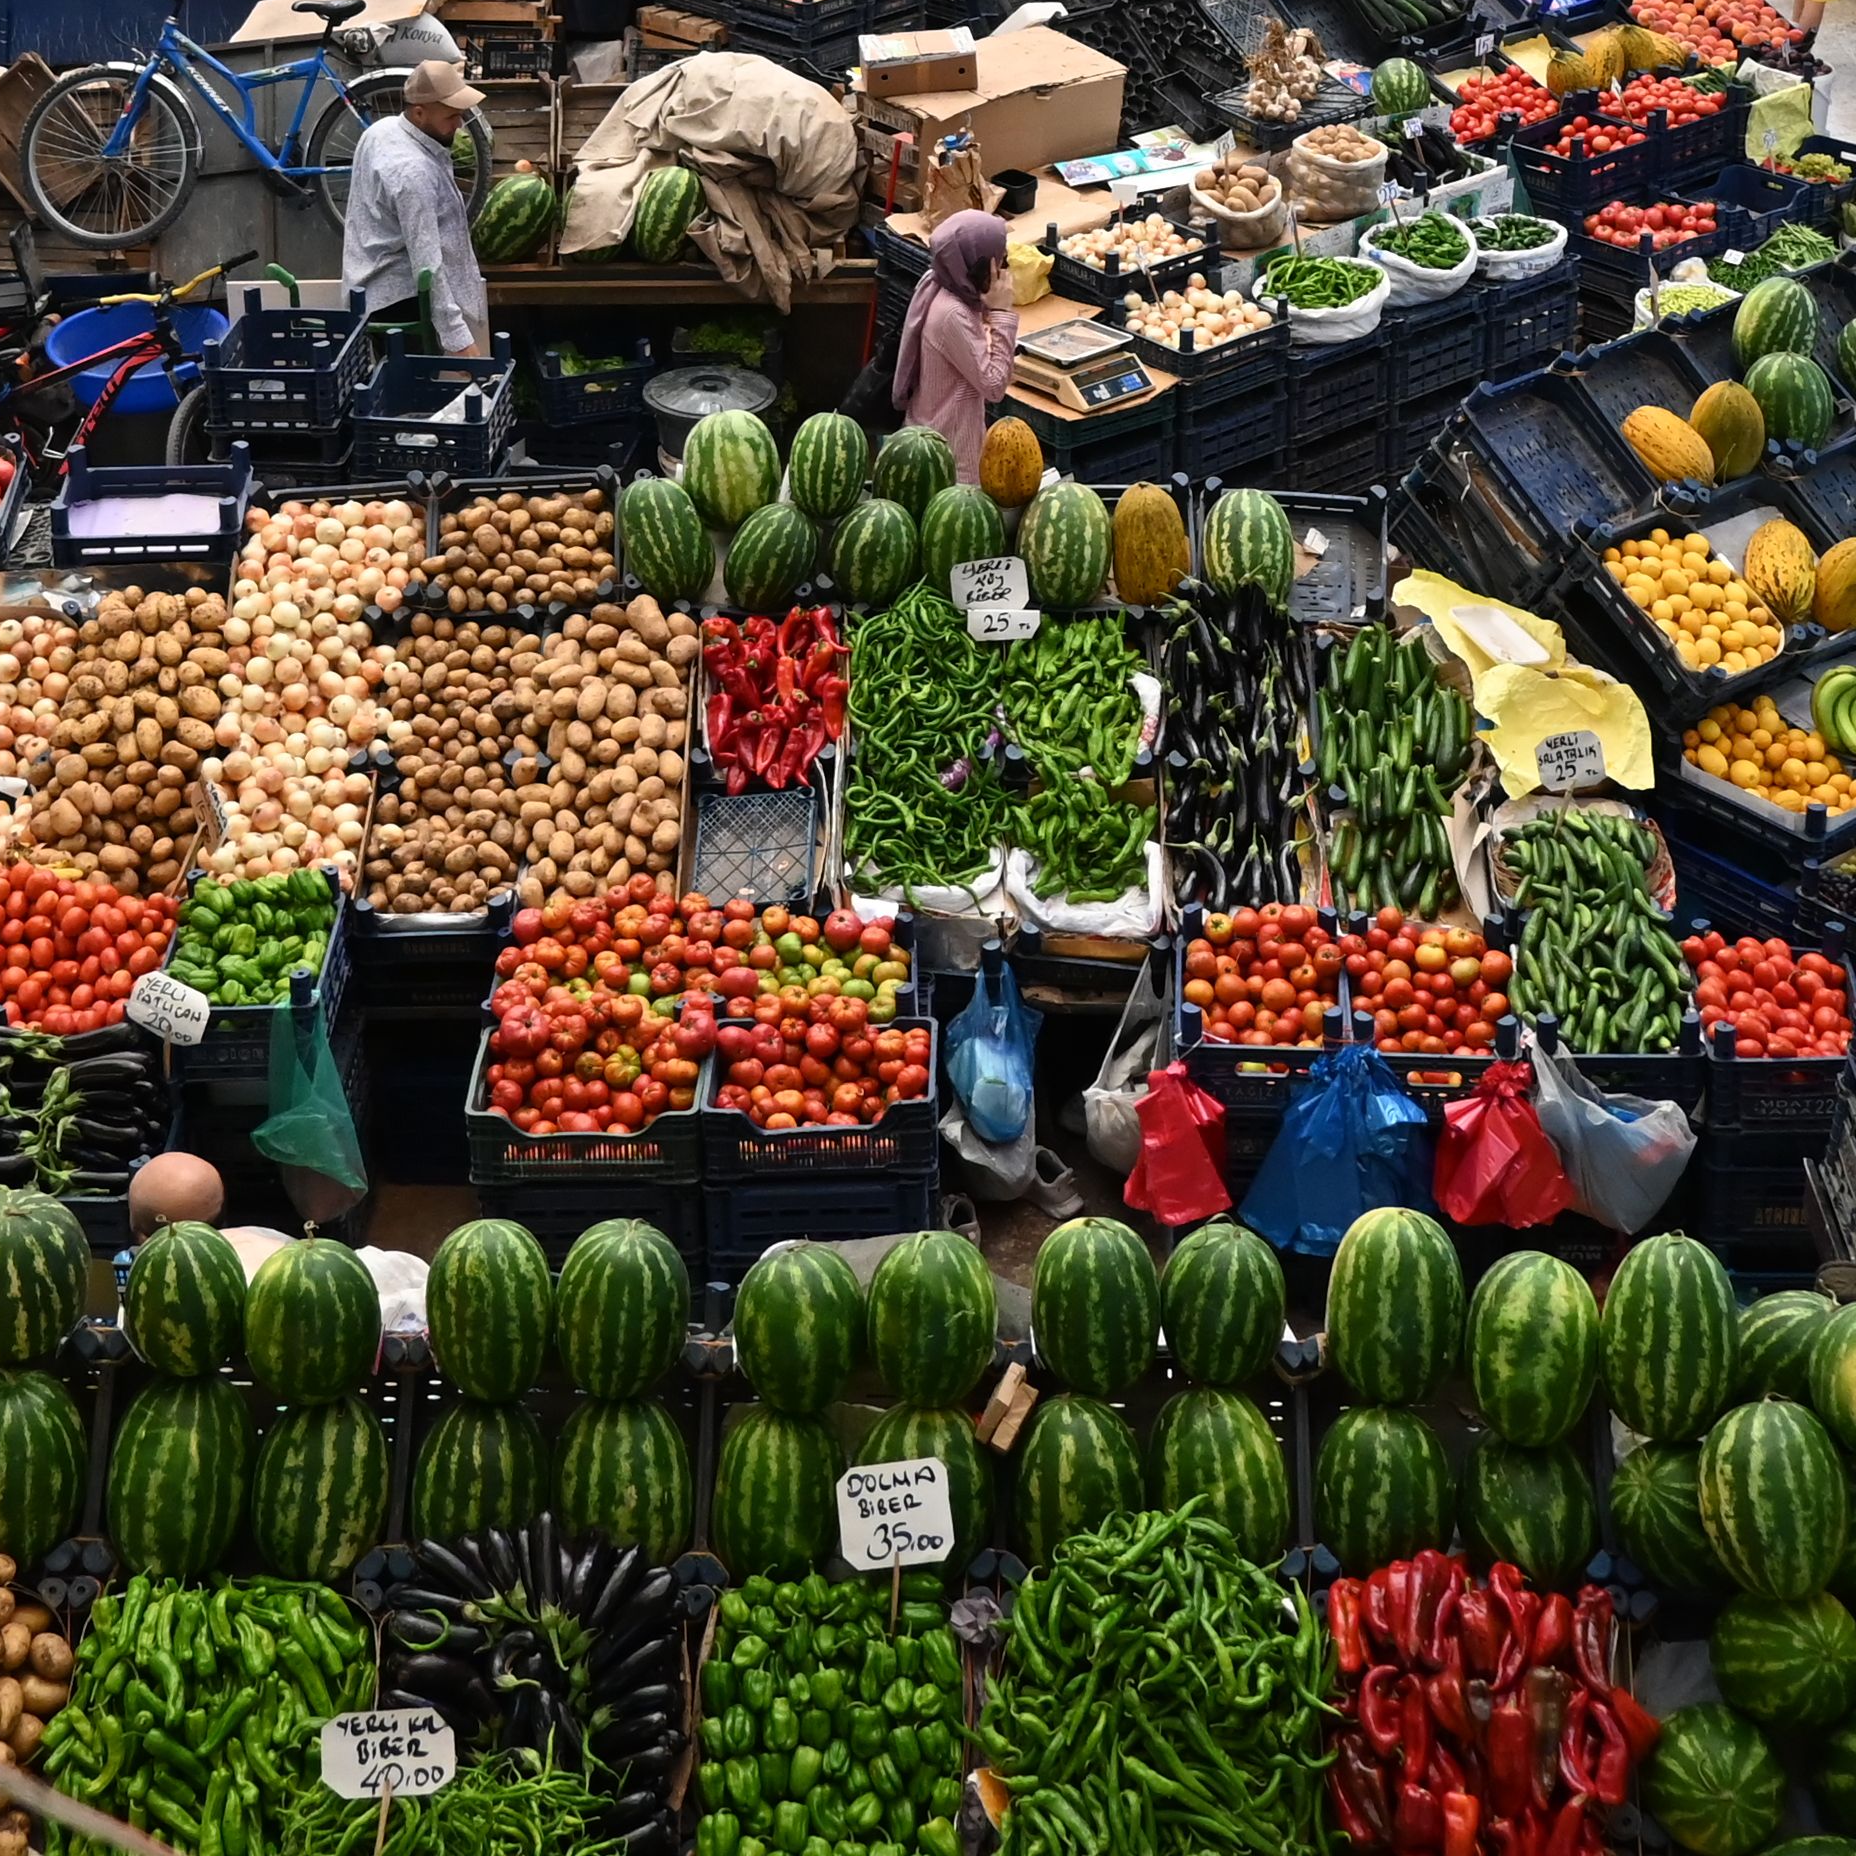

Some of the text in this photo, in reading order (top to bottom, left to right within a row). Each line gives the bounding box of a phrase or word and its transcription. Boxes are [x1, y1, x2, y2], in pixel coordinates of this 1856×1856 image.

[401, 25, 443, 45] Konya
[983, 614, 1009, 633] 25
[1555, 760, 1576, 782] 25
[847, 1464, 937, 1497] DOLMA
[858, 1491, 922, 1518] BİBER
[337, 1713, 399, 1737] YERLİ
[356, 1736, 428, 1761] BİBER
